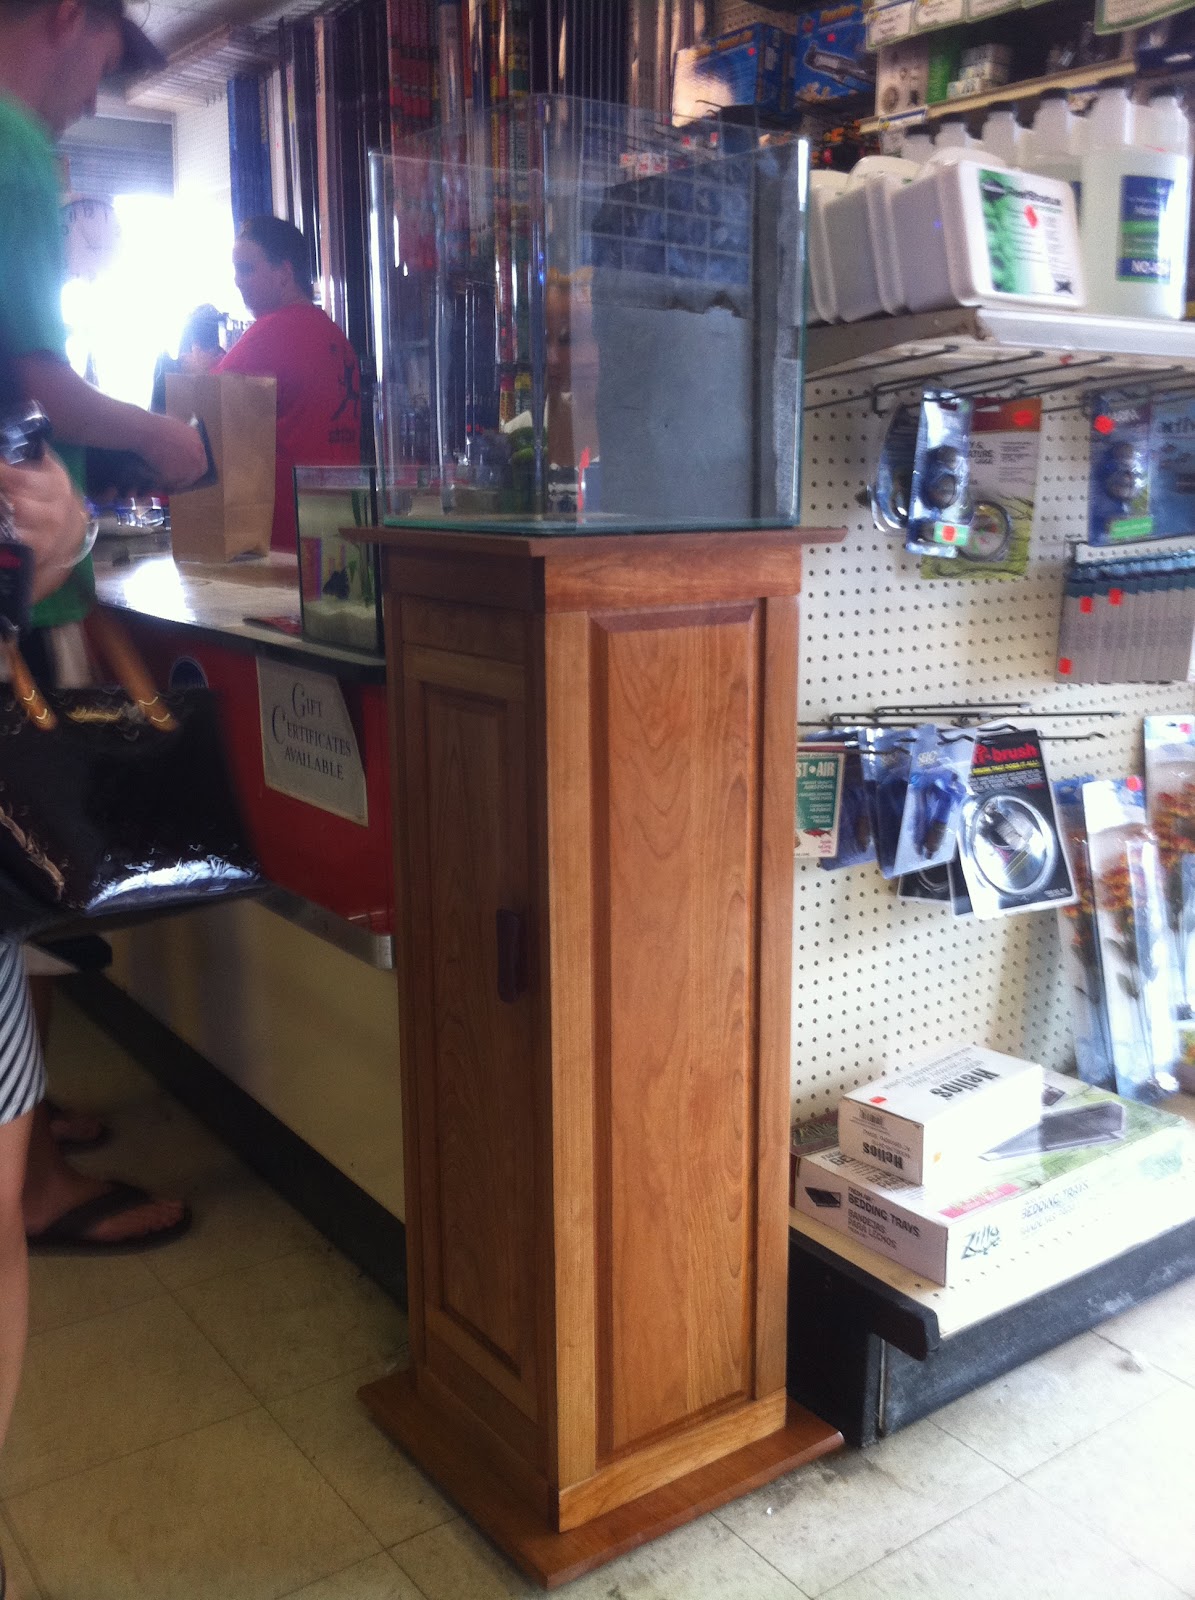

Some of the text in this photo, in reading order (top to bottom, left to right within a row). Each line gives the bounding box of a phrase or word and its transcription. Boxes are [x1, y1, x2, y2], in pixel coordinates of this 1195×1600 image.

[292, 681, 322, 718] GIFT
[272, 704, 352, 757] CERTIFICATES
[284, 746, 344, 781] AVAILABLE
[929, 1066, 1001, 1098] Helios
[862, 1141, 904, 1170] Helios
[848, 1192, 888, 1221] BEDDING
[889, 1213, 921, 1238] TRAYS
